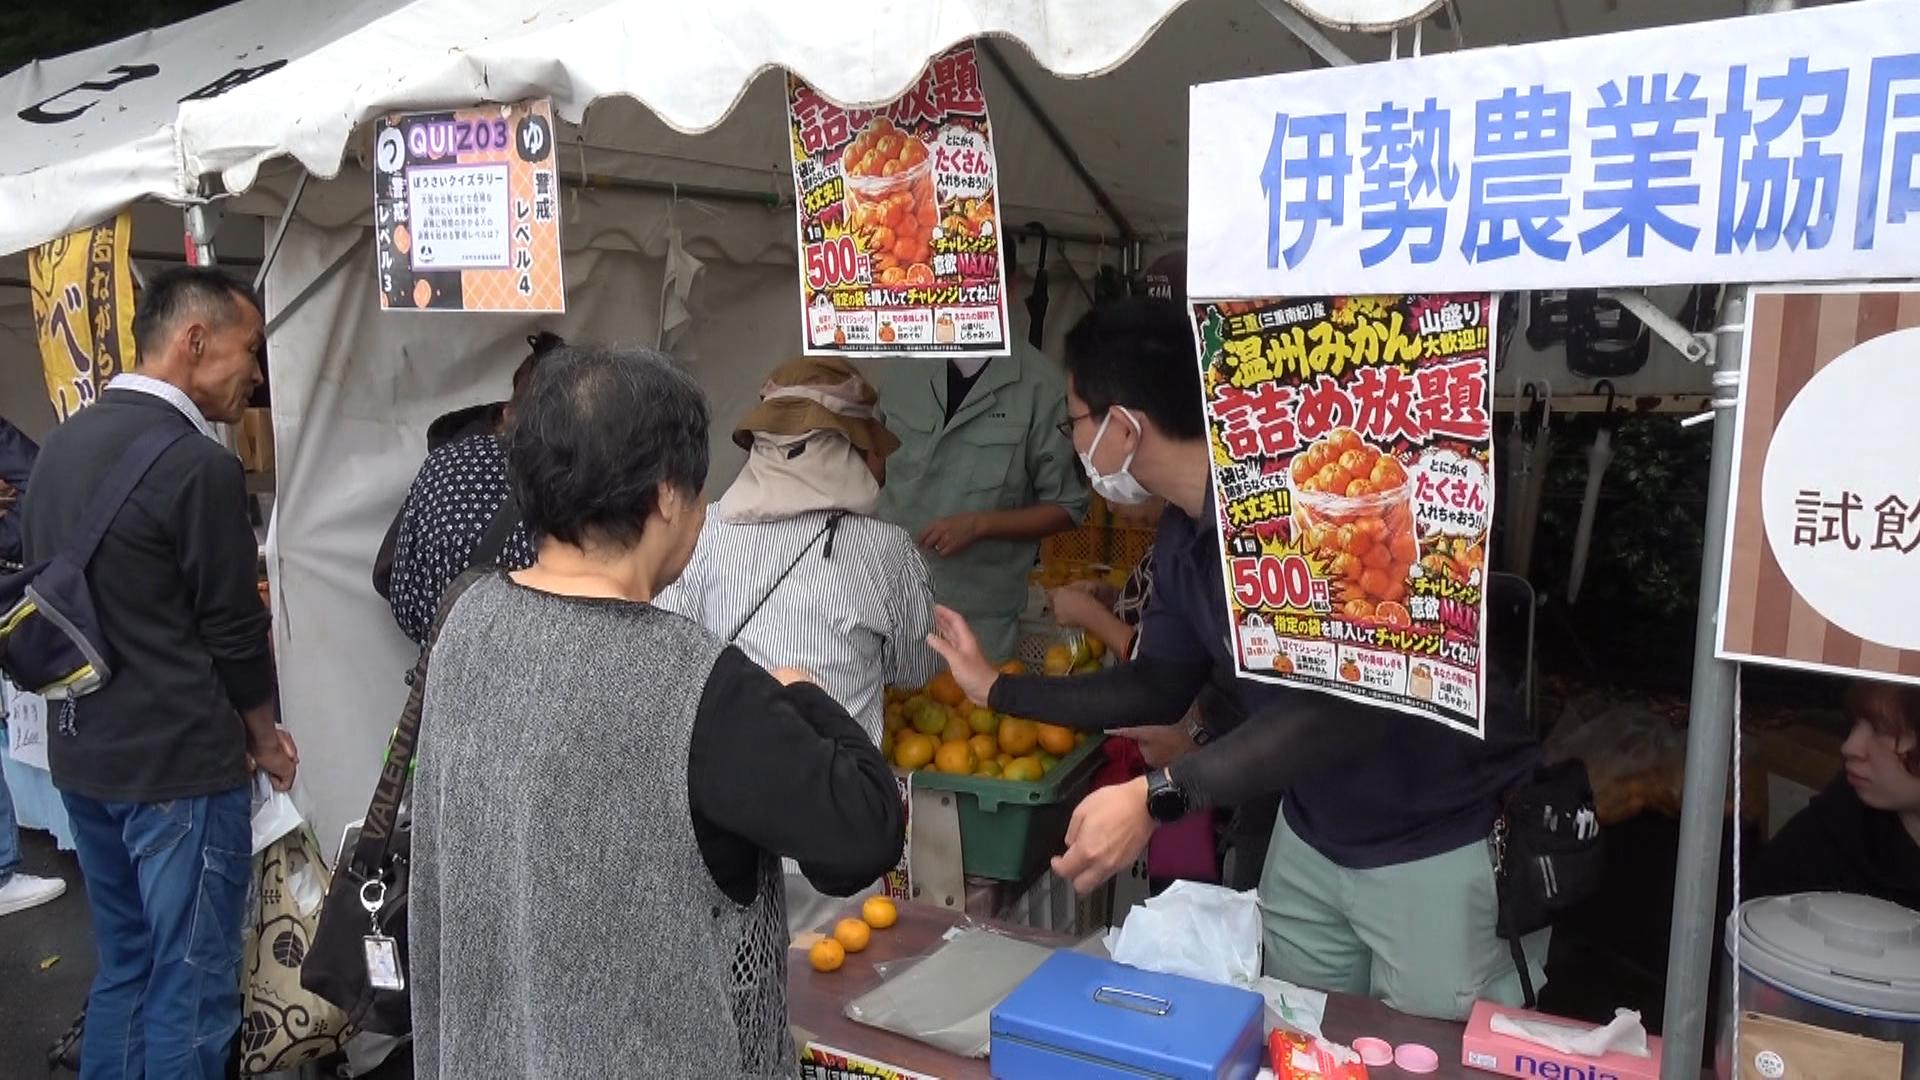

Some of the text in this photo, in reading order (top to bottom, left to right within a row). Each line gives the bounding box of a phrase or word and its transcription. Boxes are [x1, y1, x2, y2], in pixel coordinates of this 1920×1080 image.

[411, 123, 506, 157] QUIZ03
[935, 148, 989, 176] たくさん
[535, 173, 550, 220] 警戒
[805, 179, 843, 216] 大丈夫!!
[379, 205, 392, 292] レベル3
[516, 200, 531, 294] レベル4
[1418, 301, 1480, 336] 山盛り
[1222, 311, 1422, 387] 温州みかん
[1423, 327, 1487, 358] 大歓迎!!
[1213, 363, 1490, 456] 詰め放題
[1430, 459, 1468, 477] とにかく
[1230, 491, 1289, 526] 大丈夫!!
[1414, 471, 1485, 512] たくさん
[1416, 503, 1484, 531] 入れちゃおう!!
[1413, 576, 1480, 603] チャレンジ
[1274, 615, 1478, 667] 指定の袋を購入してチャレンジしてね!!
